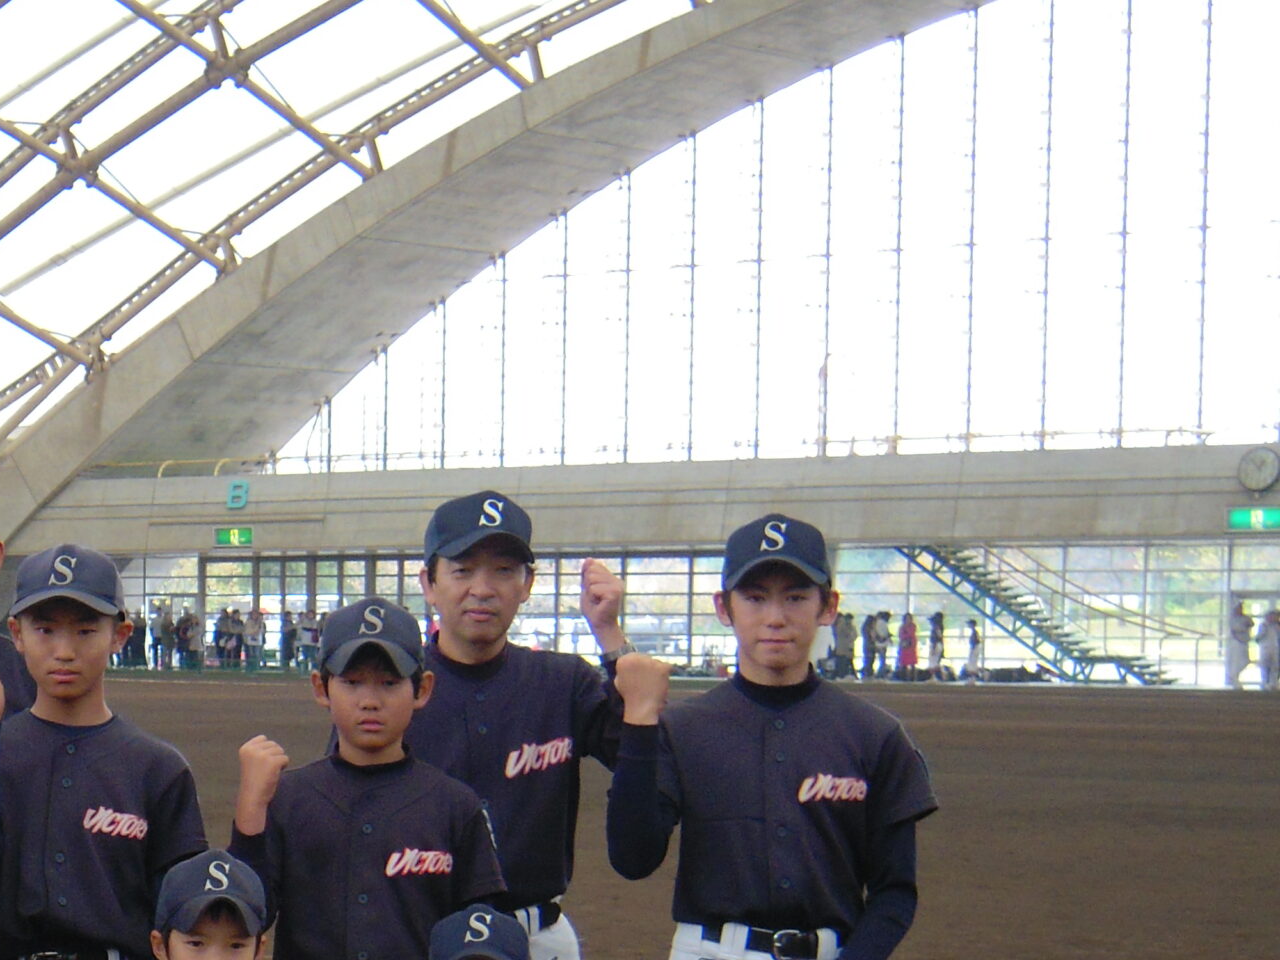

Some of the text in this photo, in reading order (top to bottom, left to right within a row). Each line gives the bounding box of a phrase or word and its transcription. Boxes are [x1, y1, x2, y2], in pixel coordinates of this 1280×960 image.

[226, 481, 249, 509] B
[478, 499, 503, 526] S
[760, 521, 787, 551] S
[48, 555, 77, 585] S
[358, 605, 384, 634] S
[204, 861, 230, 891] S
[464, 912, 491, 943] S
